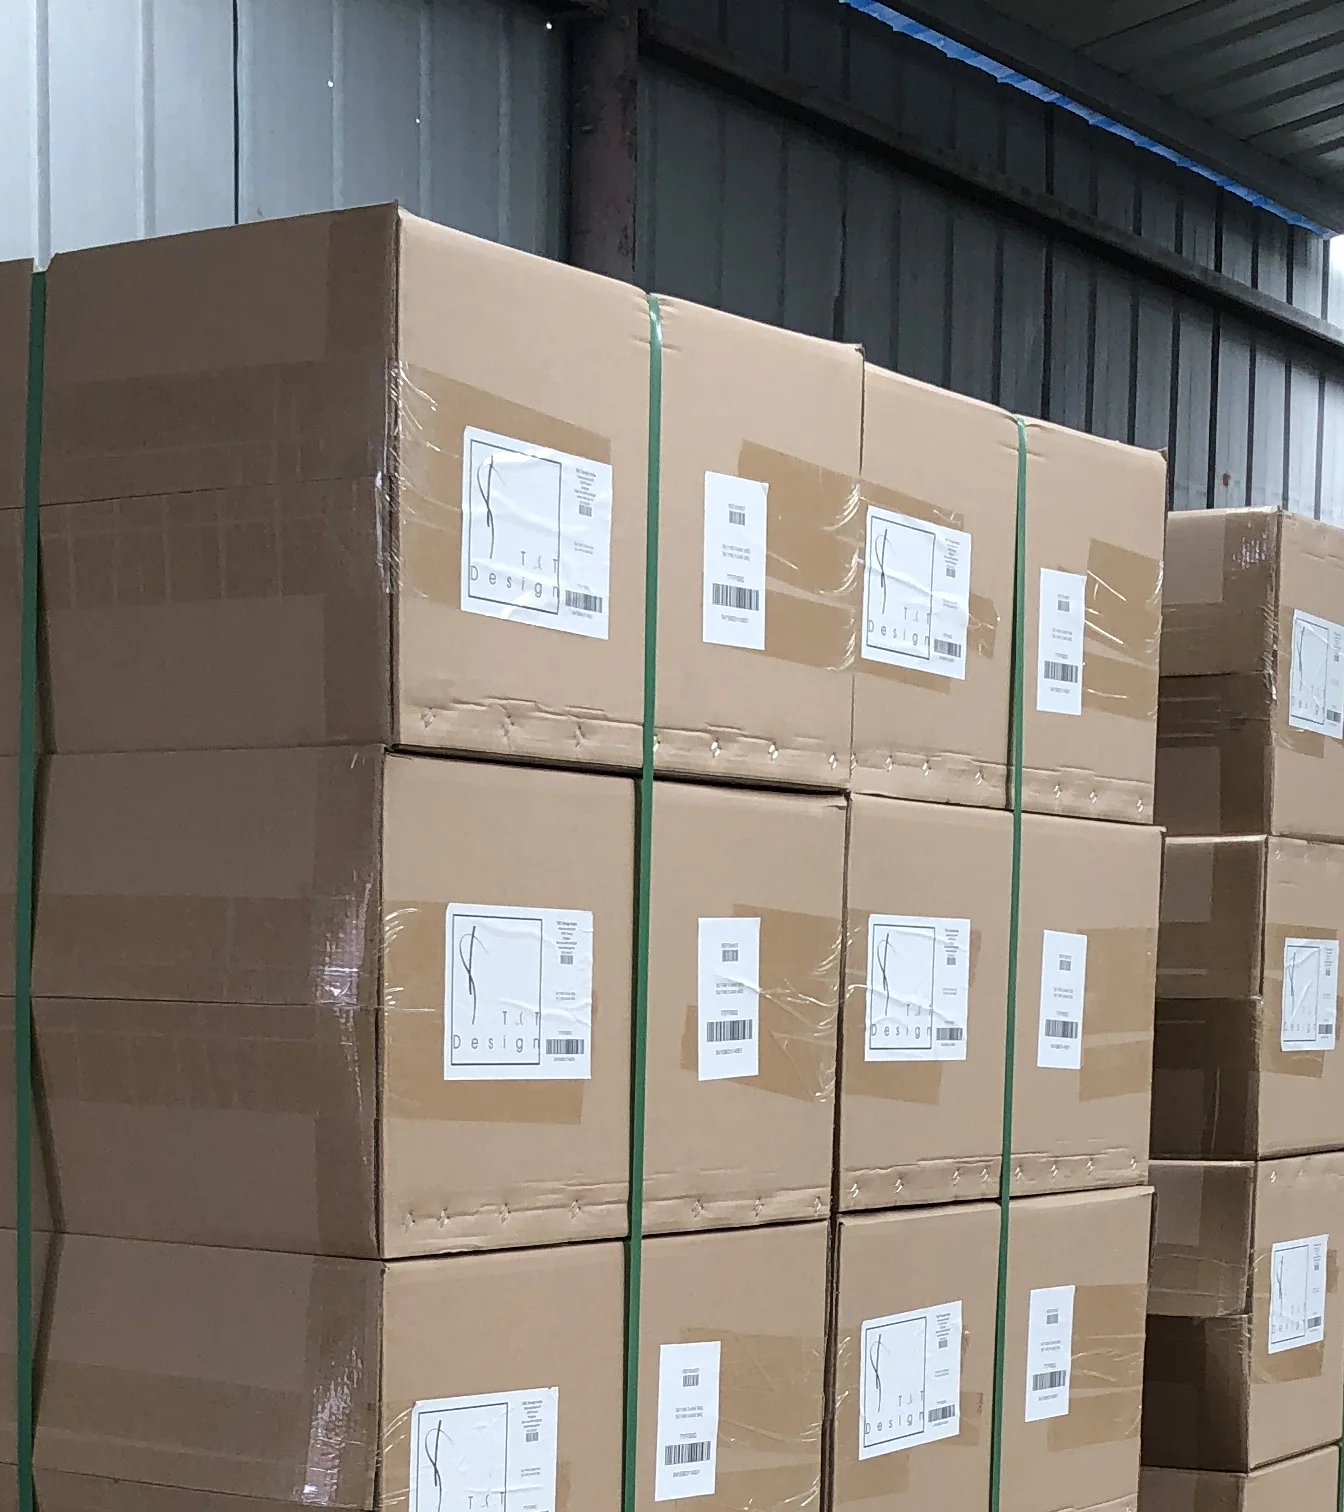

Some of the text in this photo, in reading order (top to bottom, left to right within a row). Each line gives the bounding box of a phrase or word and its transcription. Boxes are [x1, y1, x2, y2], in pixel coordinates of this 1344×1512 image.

[470, 565, 560, 598] Design
[869, 619, 930, 647] Design
[870, 1024, 932, 1039] Design
[453, 1034, 540, 1053] Design
[866, 1411, 924, 1434] Design
